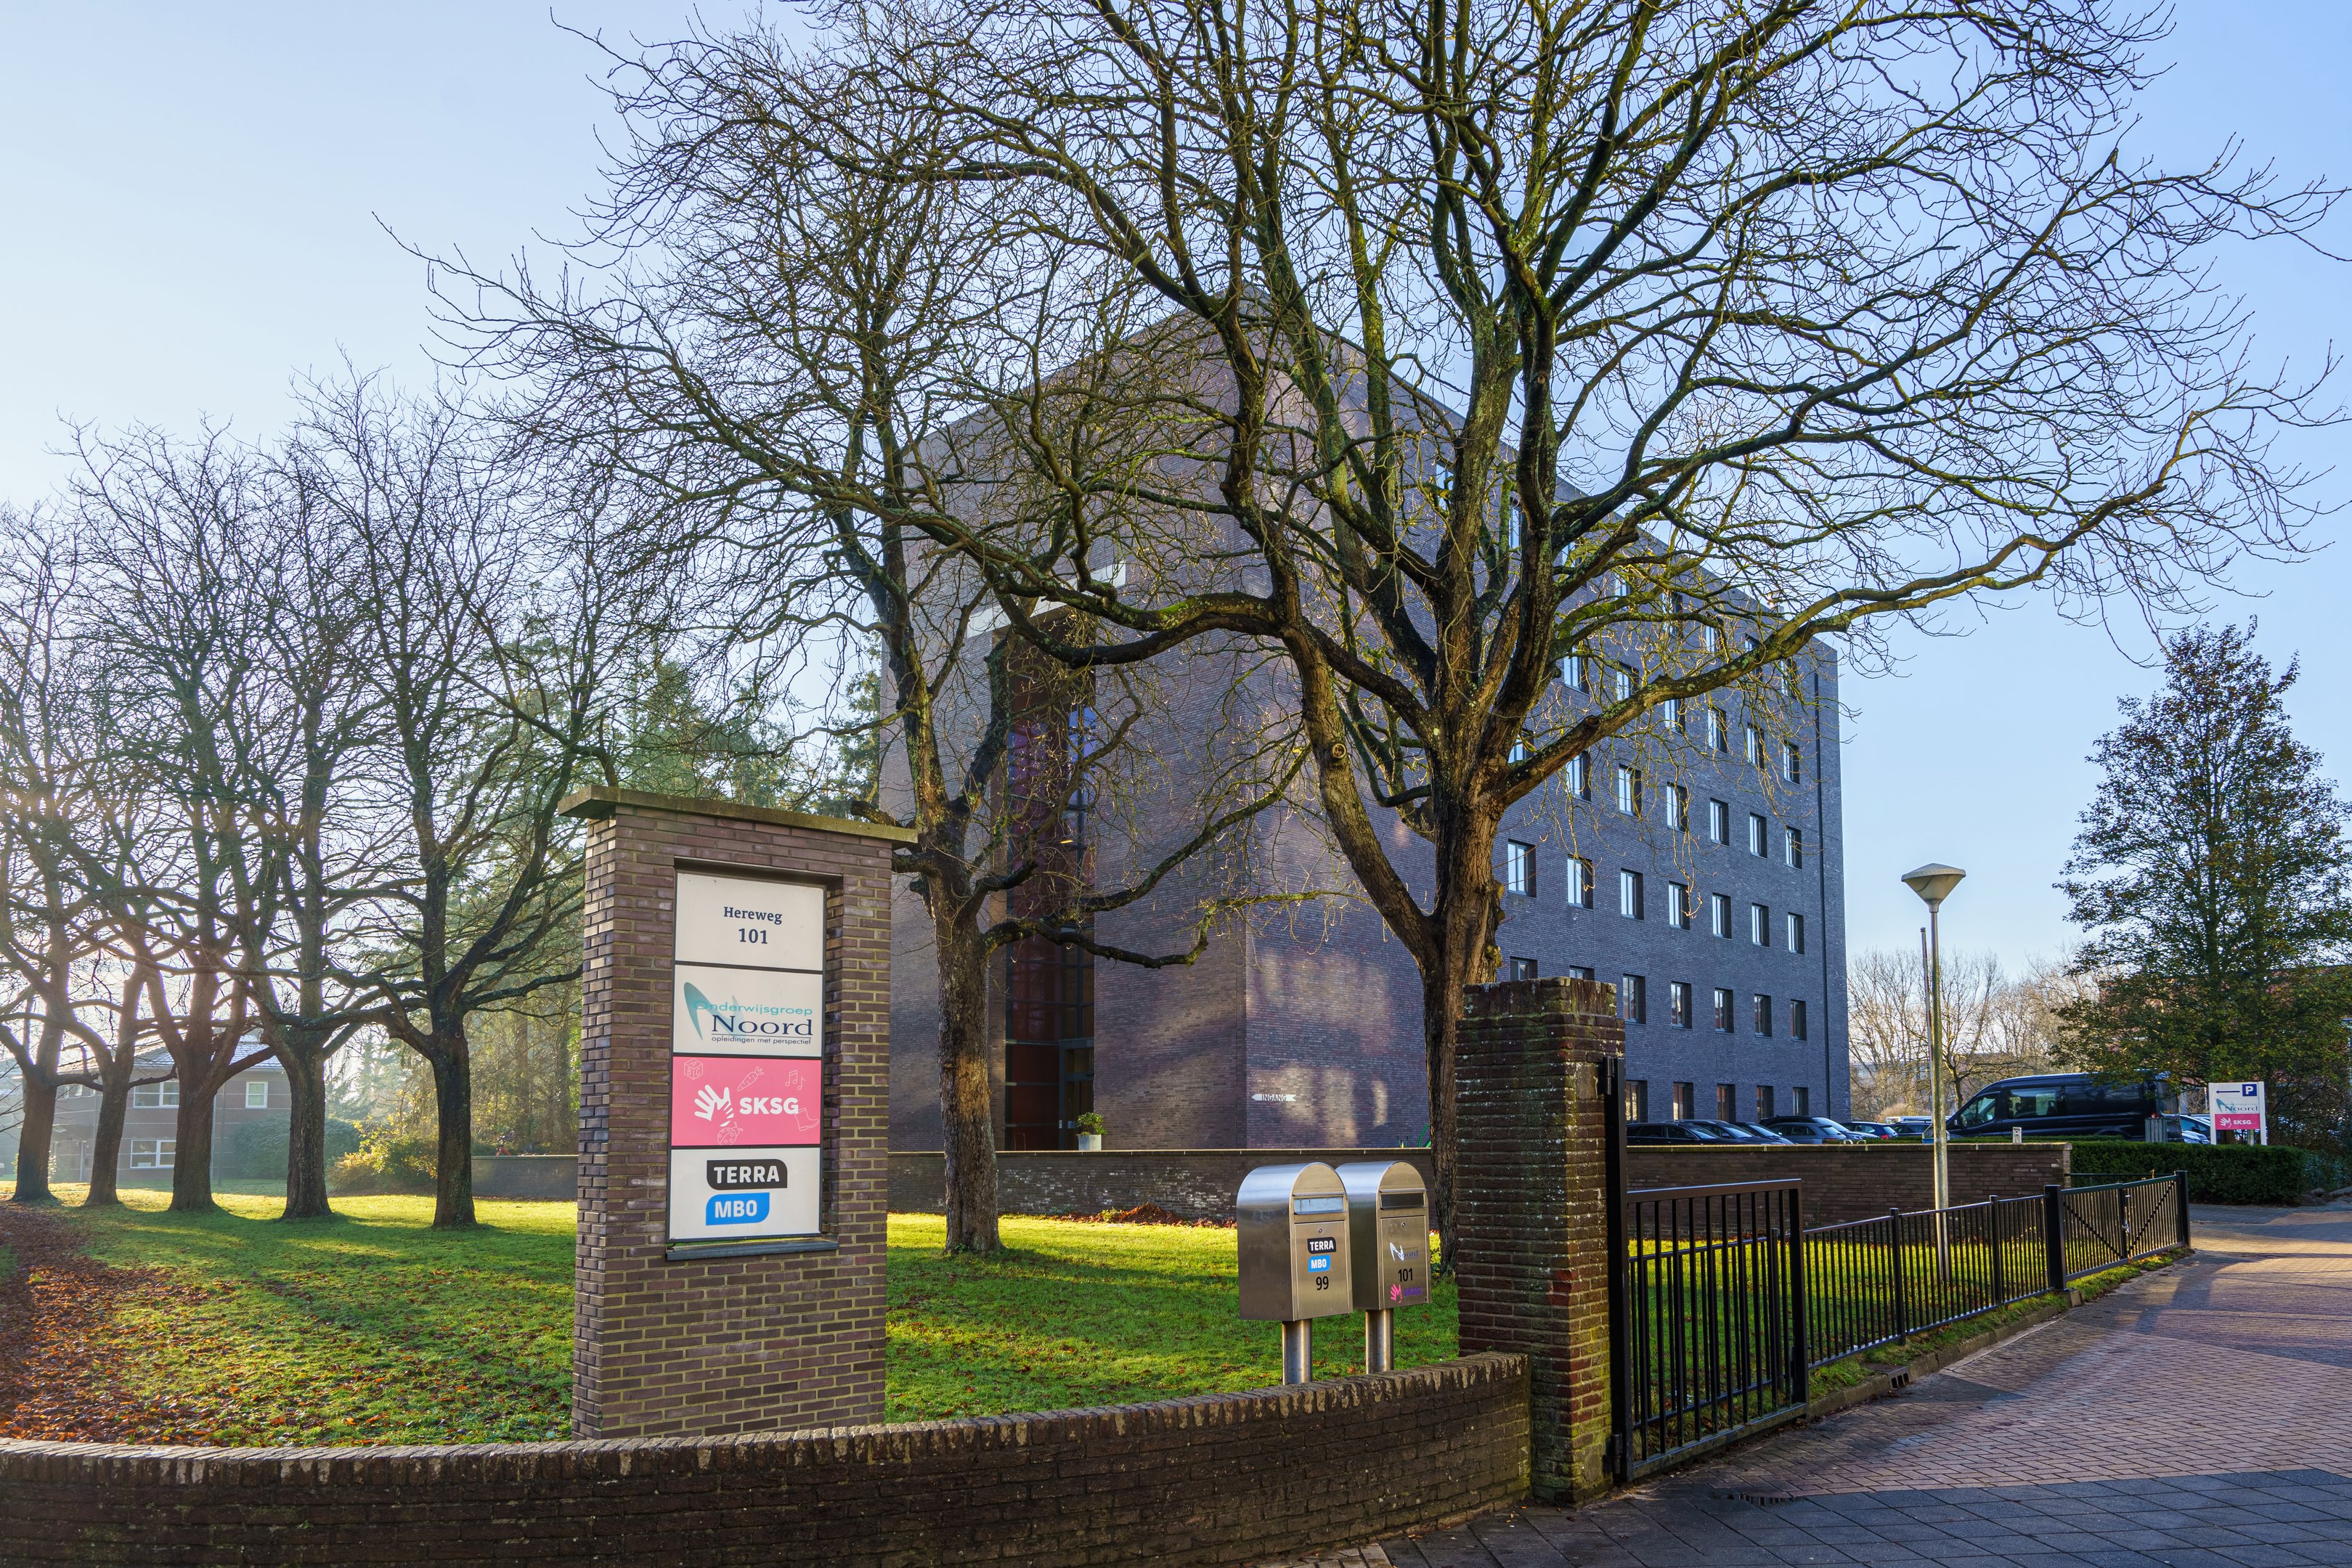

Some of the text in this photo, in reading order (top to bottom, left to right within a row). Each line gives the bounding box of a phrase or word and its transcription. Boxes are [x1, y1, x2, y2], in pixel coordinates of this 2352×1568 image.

[723, 906, 783, 926] Hereweg
[738, 928, 768, 944] 101
[692, 1000, 813, 1016] Onderwijsgroep
[711, 1015, 813, 1036] Noord
[711, 1035, 755, 1044] opleidingen
[2245, 1085, 2254, 1095] P
[739, 1097, 799, 1115] SKSG
[713, 1165, 780, 1184] TERRA
[715, 1199, 757, 1218] MBO
[1309, 1240, 1334, 1251] TERRA
[1311, 1258, 1327, 1269] MBO
[1315, 1275, 1330, 1291] 99
[1398, 1267, 1413, 1283] 101
